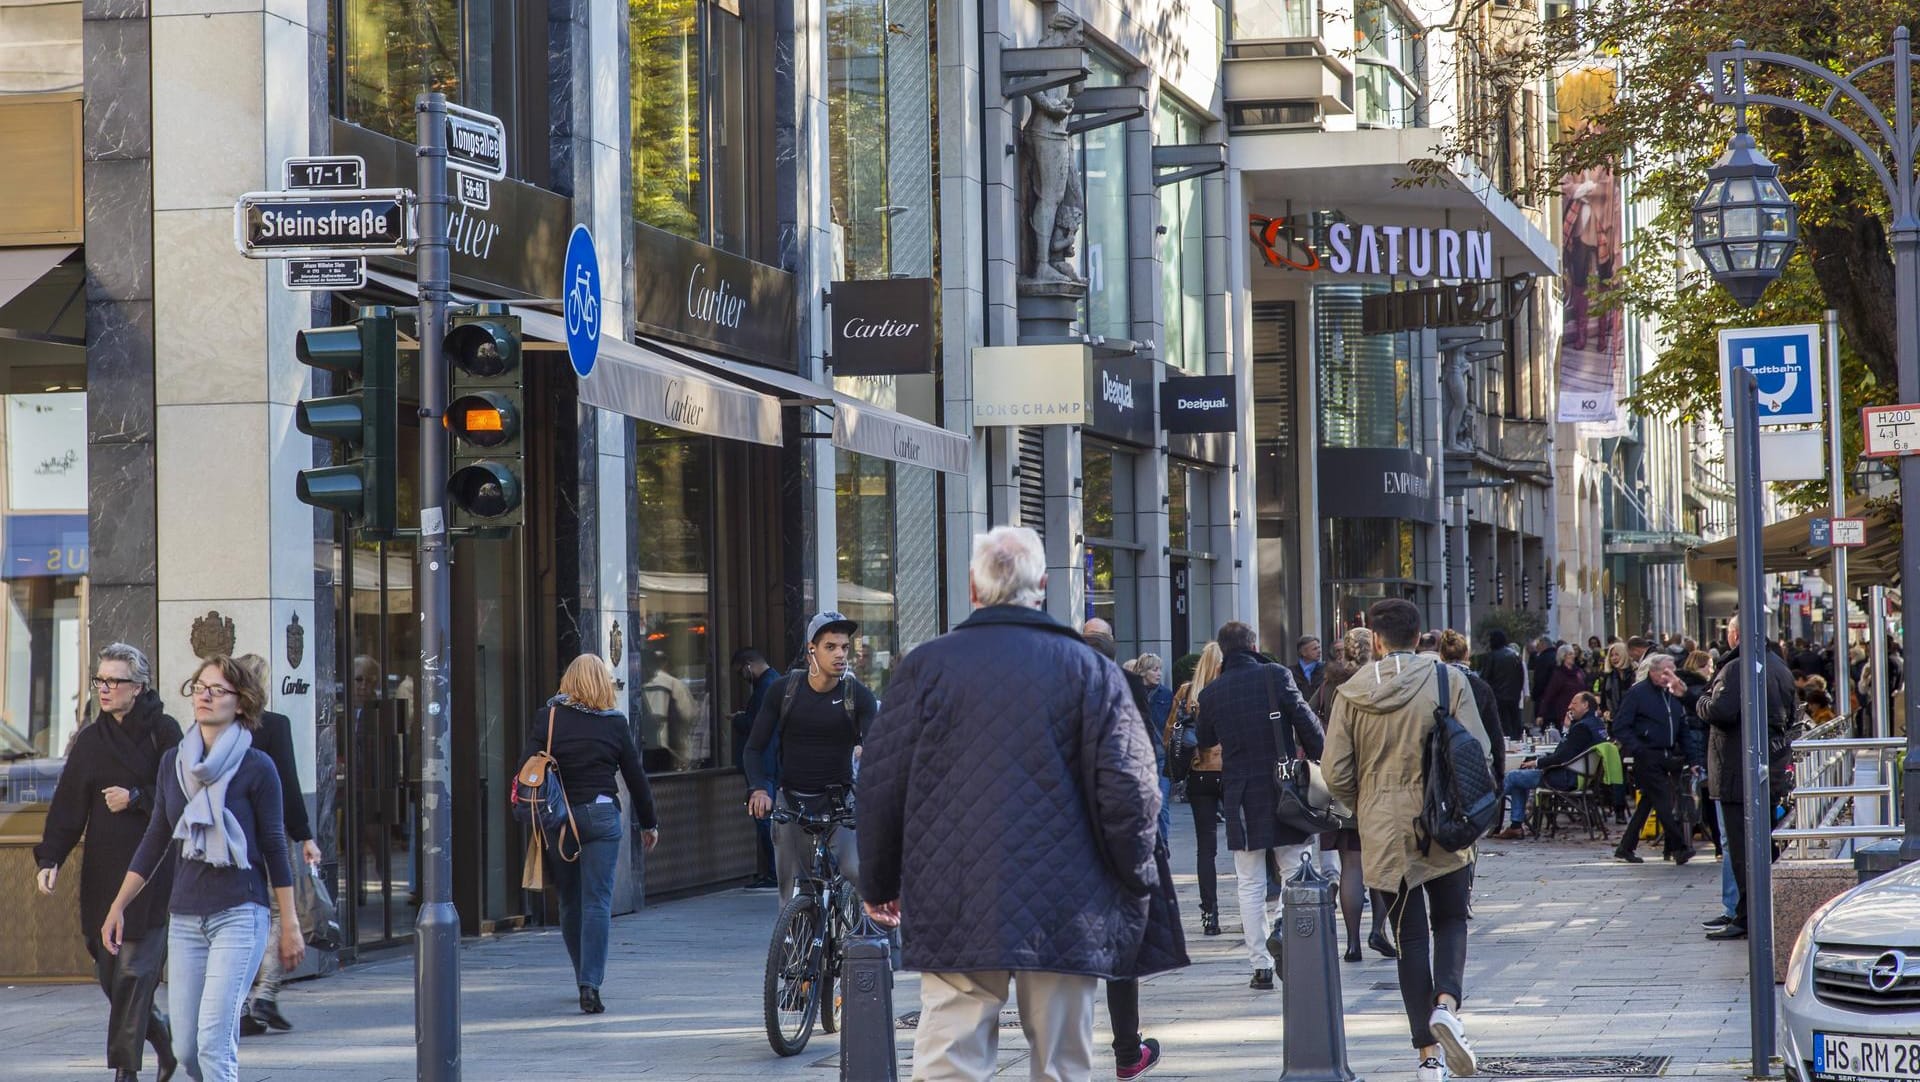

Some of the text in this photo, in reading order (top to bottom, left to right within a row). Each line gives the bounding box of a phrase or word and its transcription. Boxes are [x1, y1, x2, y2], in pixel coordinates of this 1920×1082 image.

[306, 166, 342, 185] 17-1
[261, 208, 388, 239] Steinstraße
[446, 204, 499, 260] rtier
[1329, 222, 1492, 279] SATURN
[687, 263, 746, 329] Cartier
[843, 317, 920, 339] Cartier
[664, 379, 704, 427] Cartier
[976, 402, 1082, 417] LONGCHAMP
[893, 424, 920, 462] Cartier
[282, 676, 310, 696] Cartier
[1826, 1039, 1920, 1075] HS RM 28
